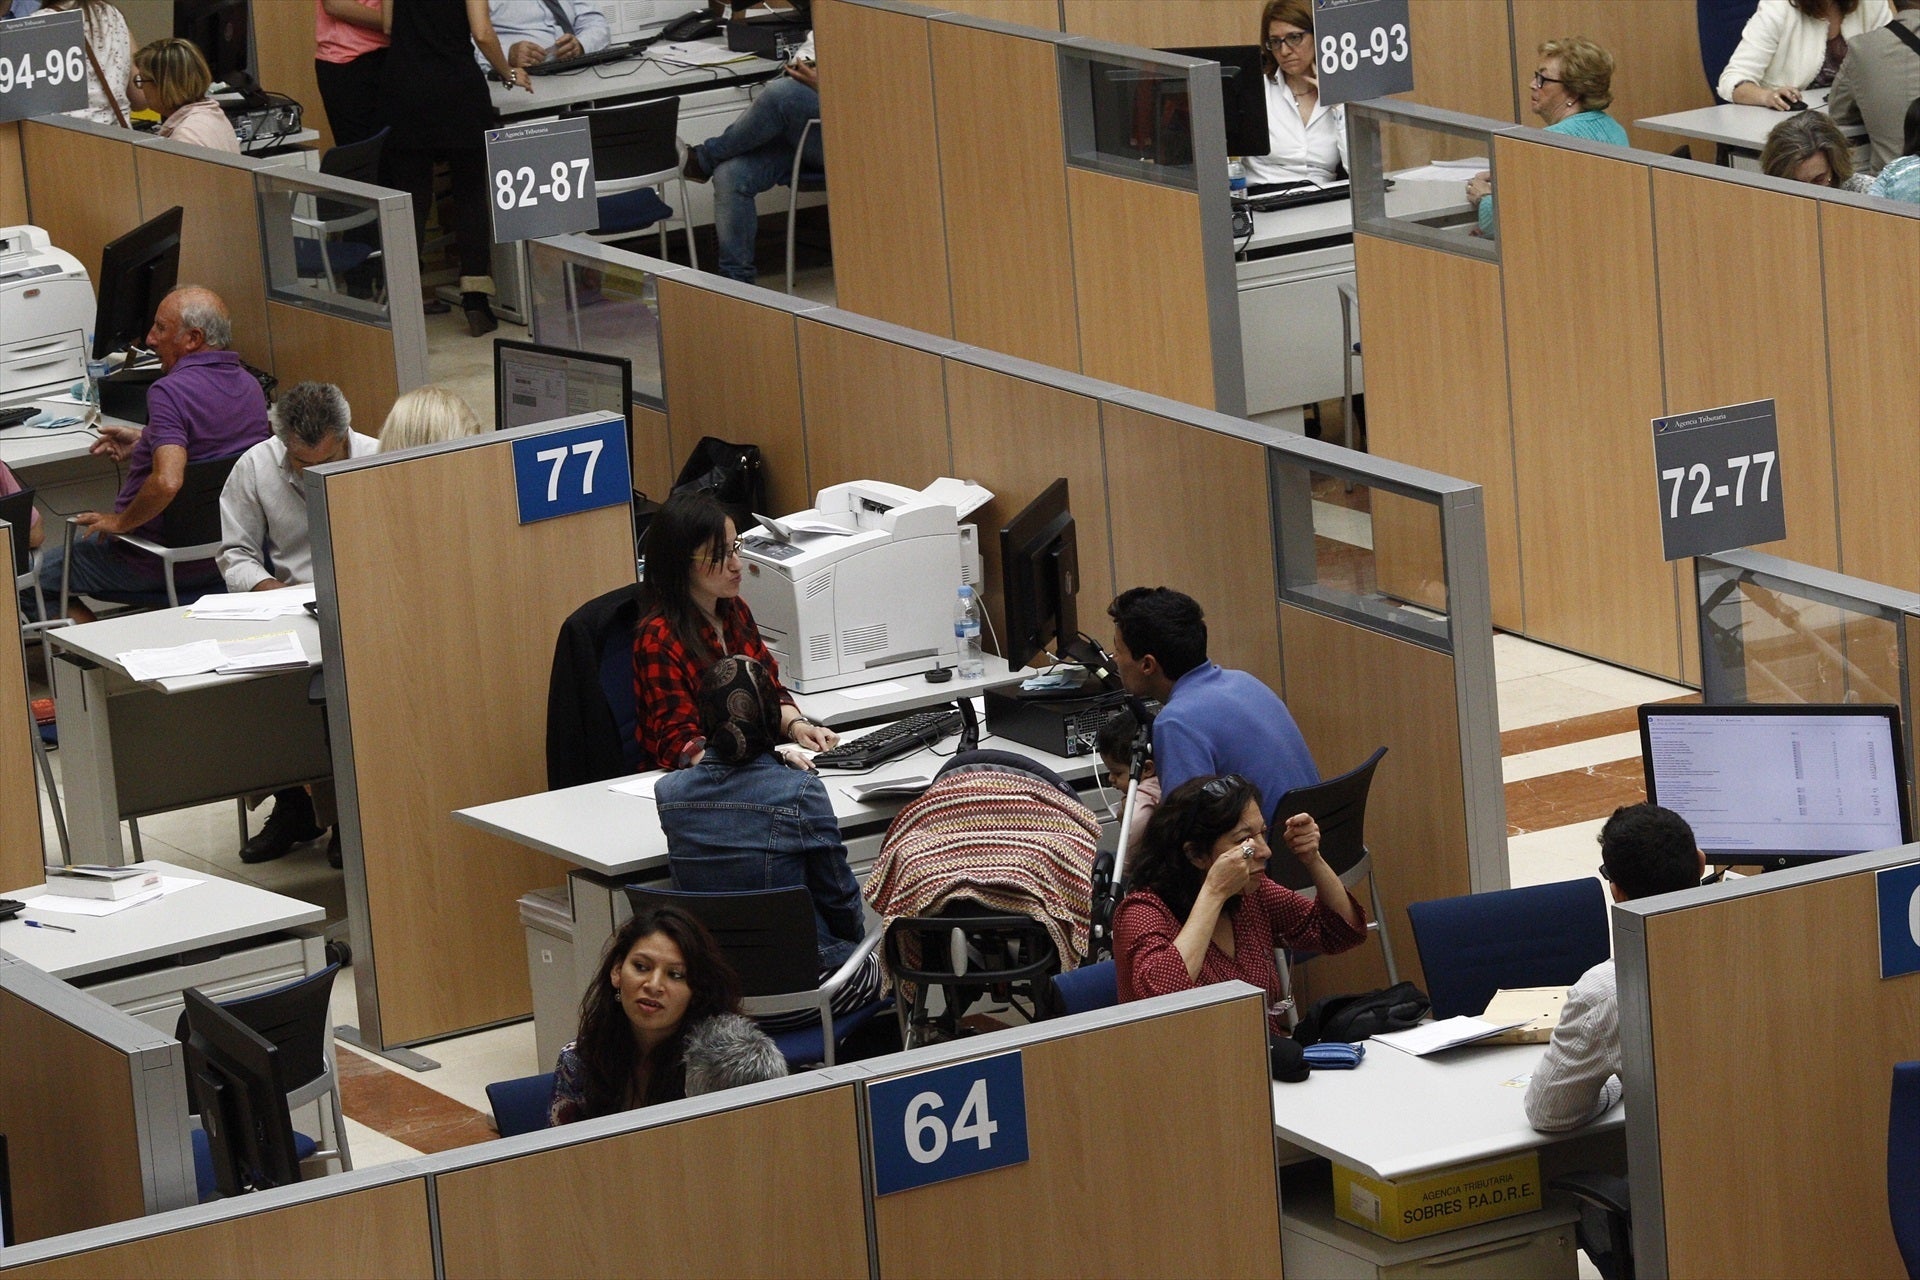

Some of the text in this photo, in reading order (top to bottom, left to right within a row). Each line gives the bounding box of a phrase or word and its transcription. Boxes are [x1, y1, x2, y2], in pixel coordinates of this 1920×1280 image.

[0, 45, 84, 94] 94-96
[1321, 23, 1408, 75] 88-93
[495, 158, 590, 211] 82-87
[1674, 413, 1727, 429] Agencia Tributaria
[536, 439, 604, 502] 77
[1662, 450, 1775, 519] 72-77
[904, 1078, 998, 1164] 64
[1403, 1199, 1462, 1224] SOBRES
[1468, 1183, 1535, 1209] P.A.D.R.E.
[1423, 1173, 1514, 1201] AGENCIA TRIBUTARIA
